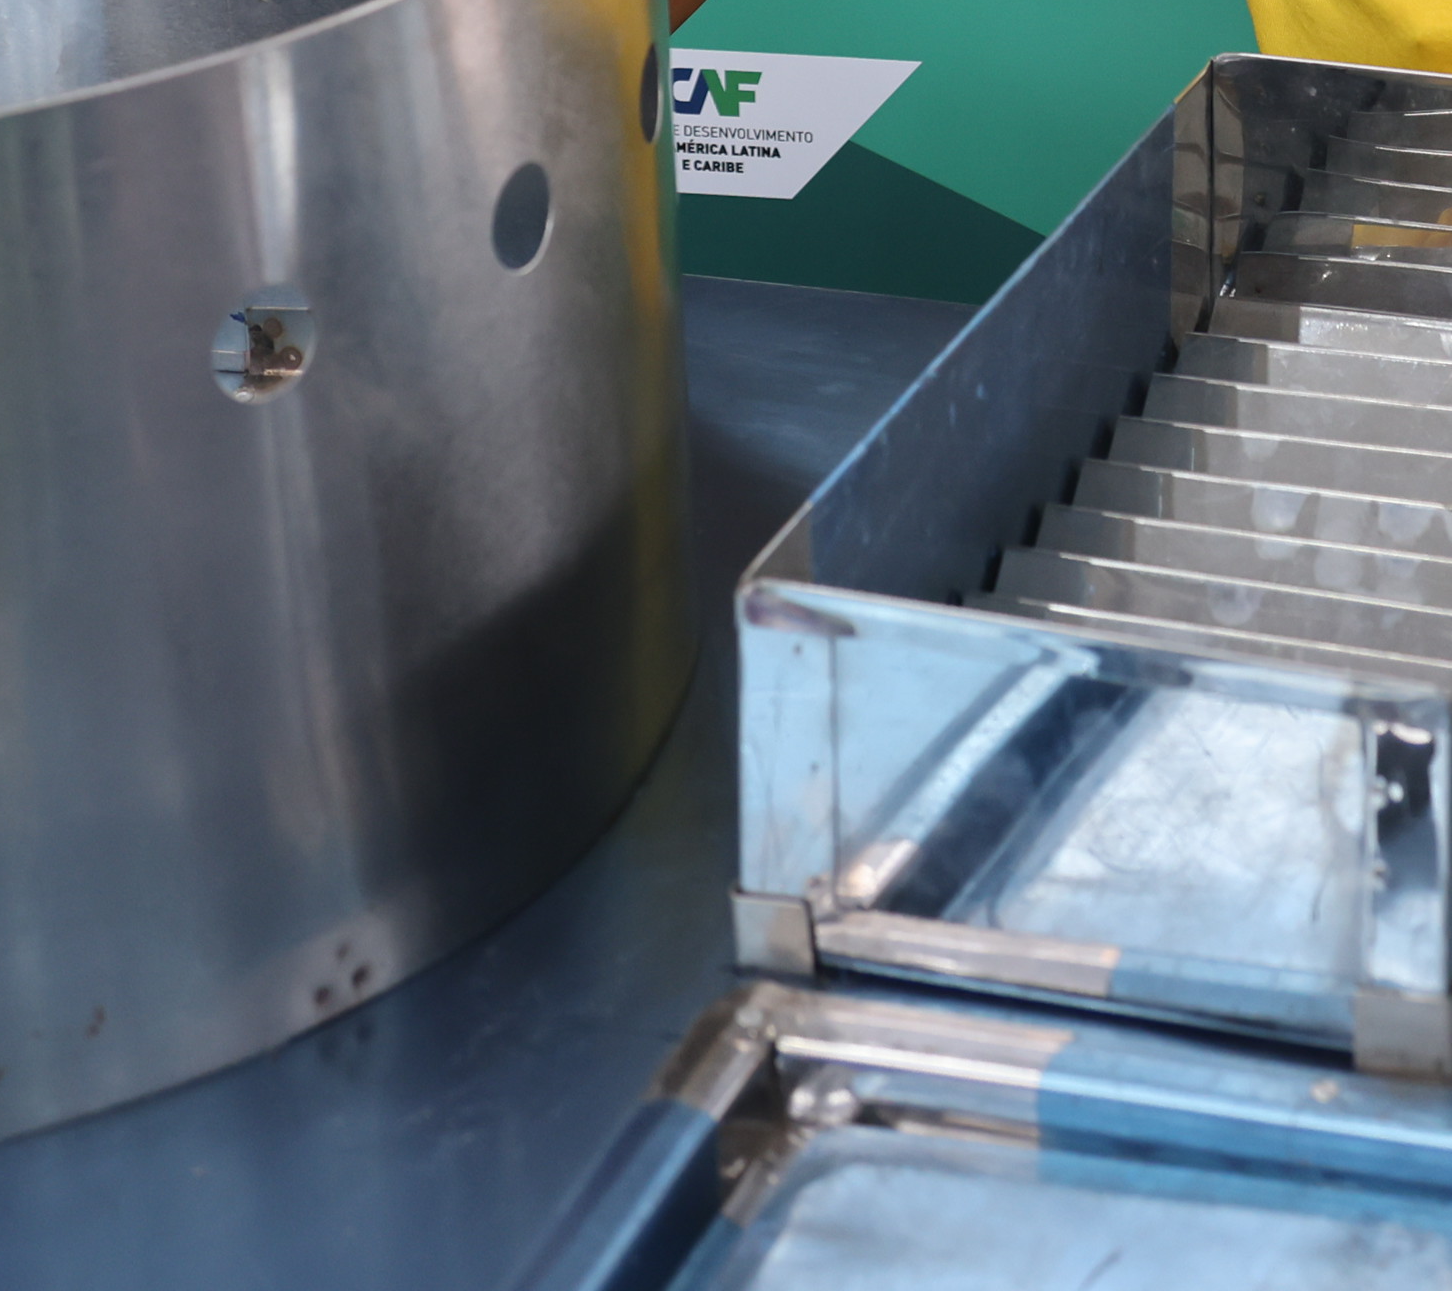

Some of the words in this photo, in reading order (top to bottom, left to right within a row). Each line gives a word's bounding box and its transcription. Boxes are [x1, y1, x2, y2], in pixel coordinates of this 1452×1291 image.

[672, 67, 762, 118] CAF
[683, 124, 814, 144] DESENVOLVIMENTO
[674, 139, 728, 156] MÉRICA
[731, 145, 781, 159] LATINA
[682, 159, 691, 171] E
[694, 160, 744, 174] CARIBE
